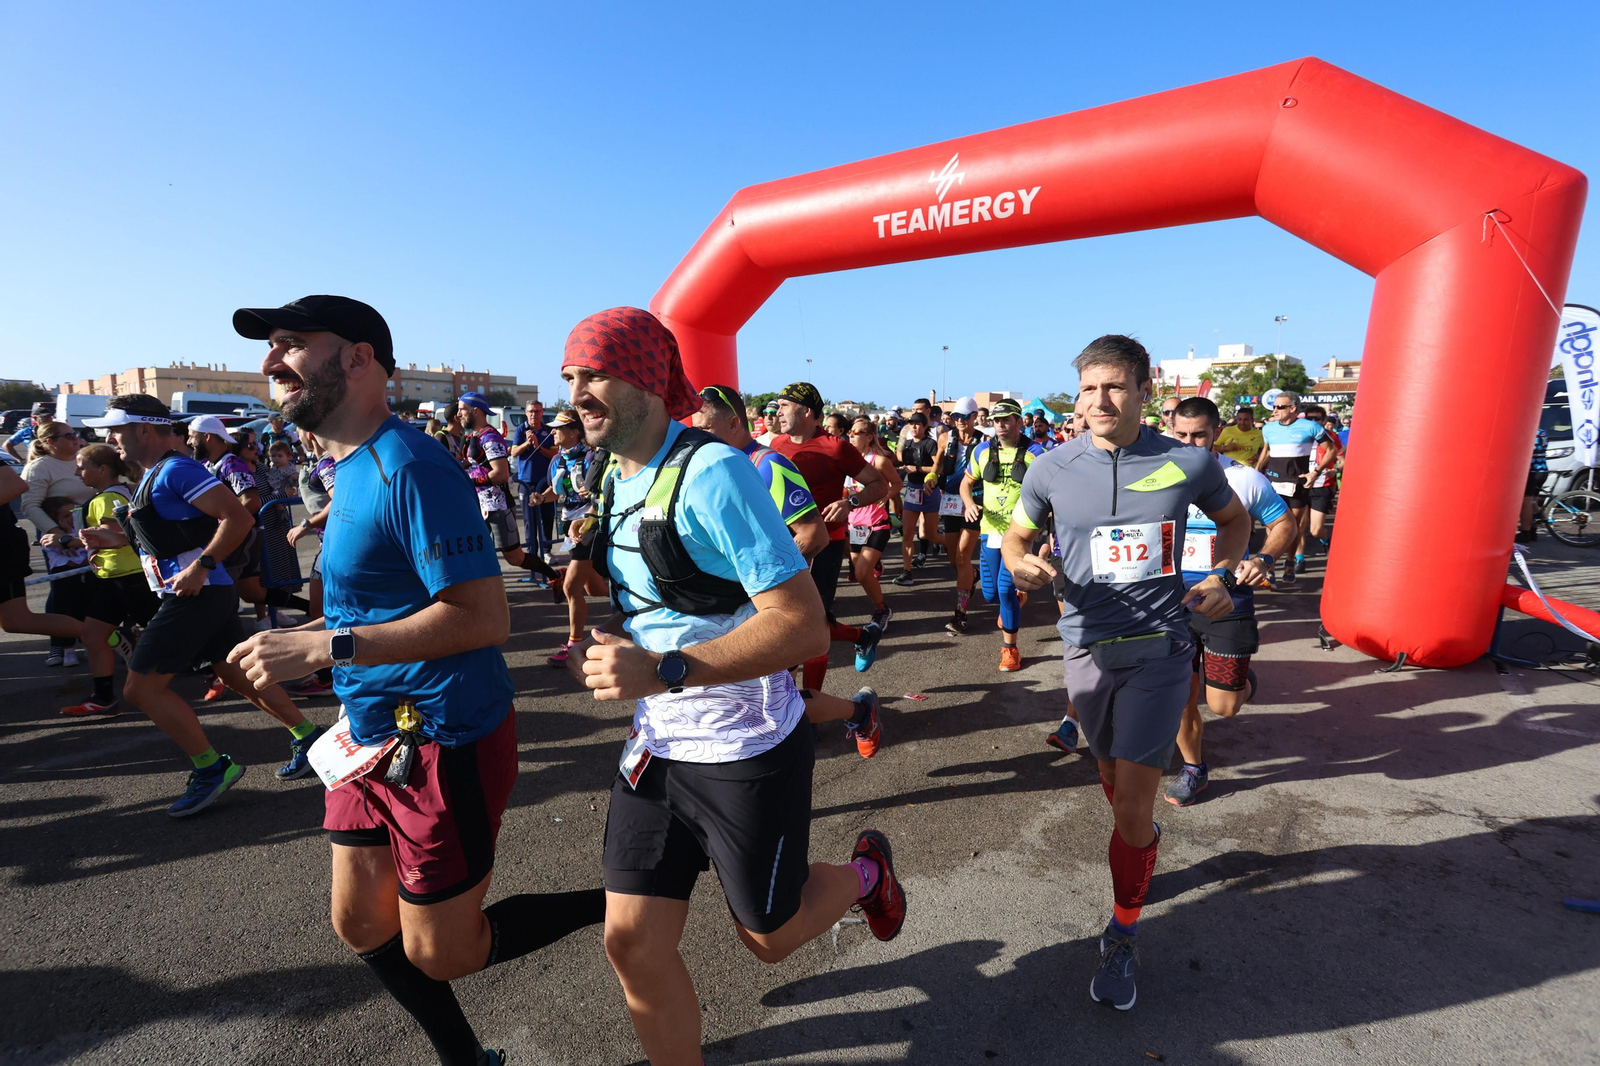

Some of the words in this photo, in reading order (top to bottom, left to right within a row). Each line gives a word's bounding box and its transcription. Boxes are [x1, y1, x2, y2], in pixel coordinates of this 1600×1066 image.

[872, 186, 1042, 239] TEAMERGY
[418, 534, 483, 570] ENDLESS
[1108, 543, 1149, 563] 312
[1163, 530, 1172, 567] PIRATA
[333, 730, 364, 758] 444
[341, 747, 389, 783] PIRATA
